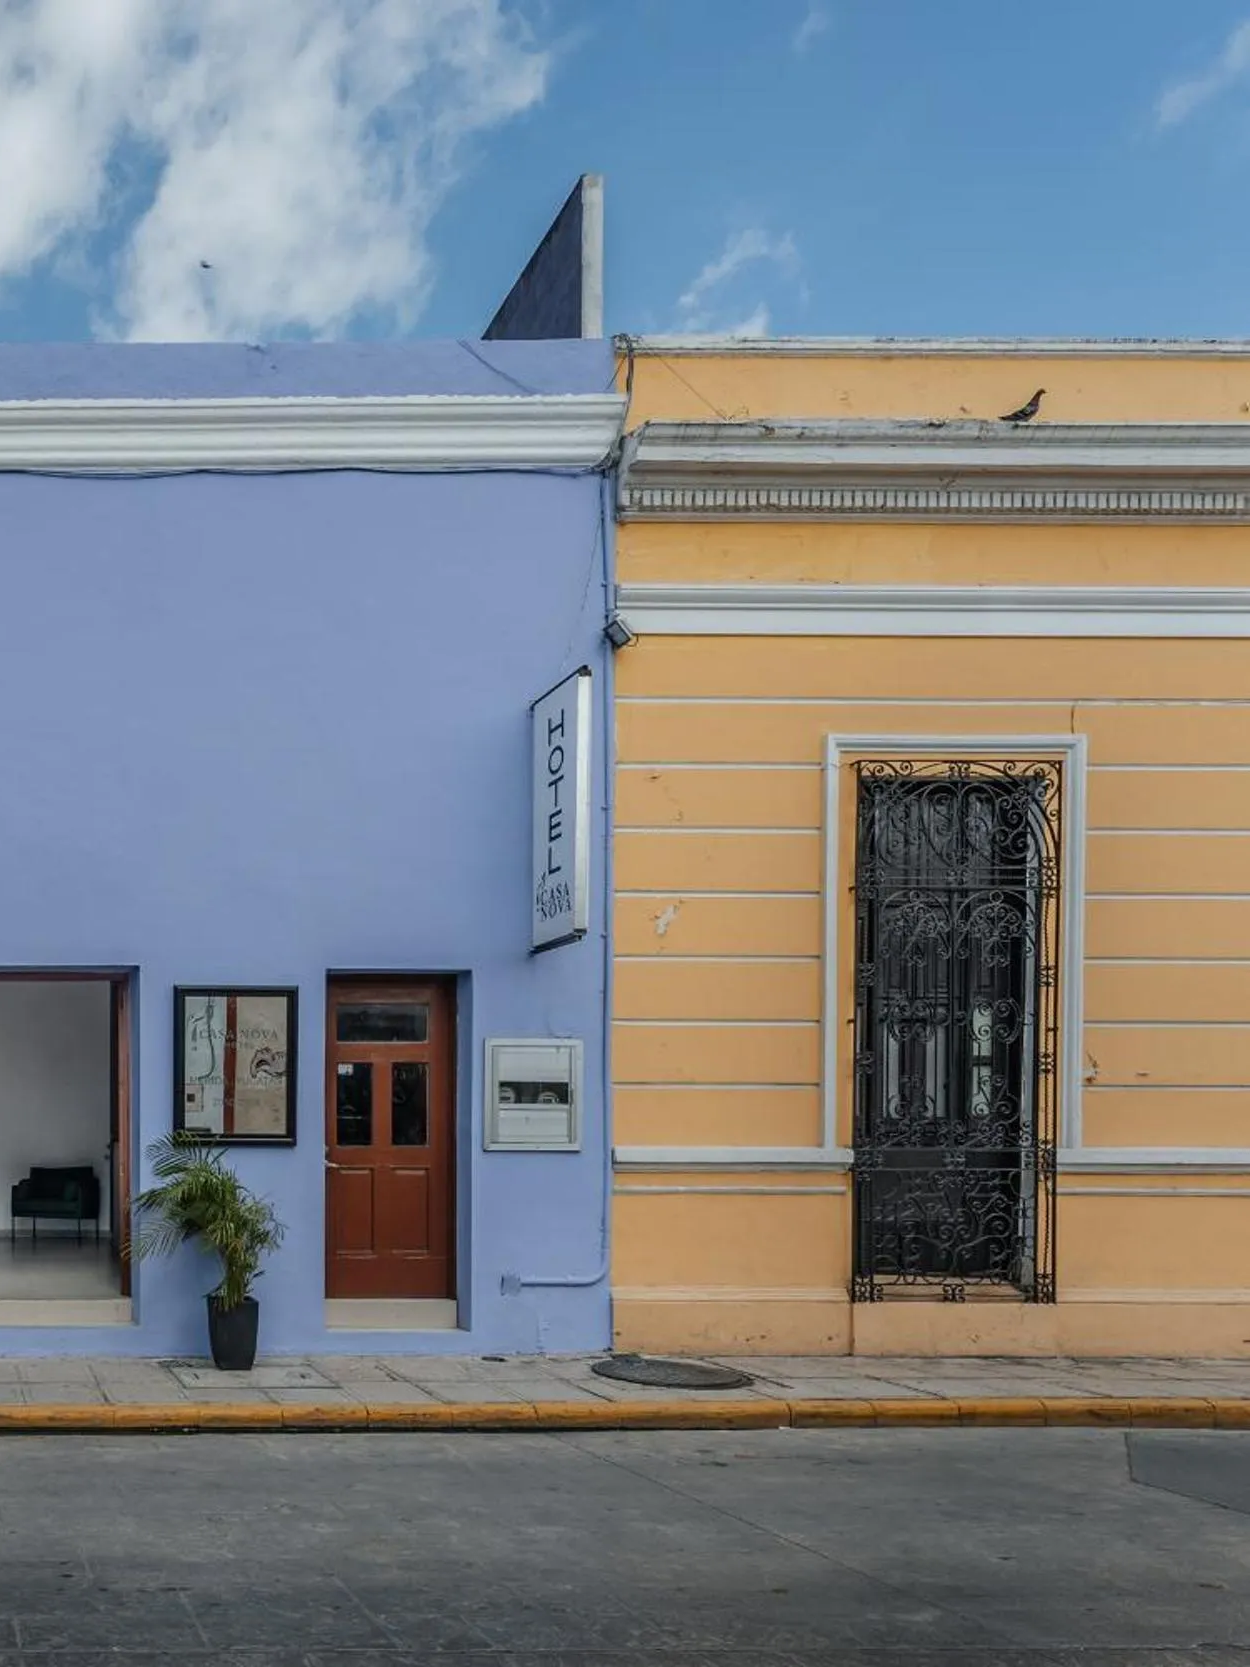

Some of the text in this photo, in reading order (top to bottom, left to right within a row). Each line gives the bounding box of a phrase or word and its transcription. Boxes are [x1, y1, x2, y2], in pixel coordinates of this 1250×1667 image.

[547, 708, 564, 876] HOTEL
[540, 881, 570, 907] CASA
[540, 897, 572, 922] NOVA
